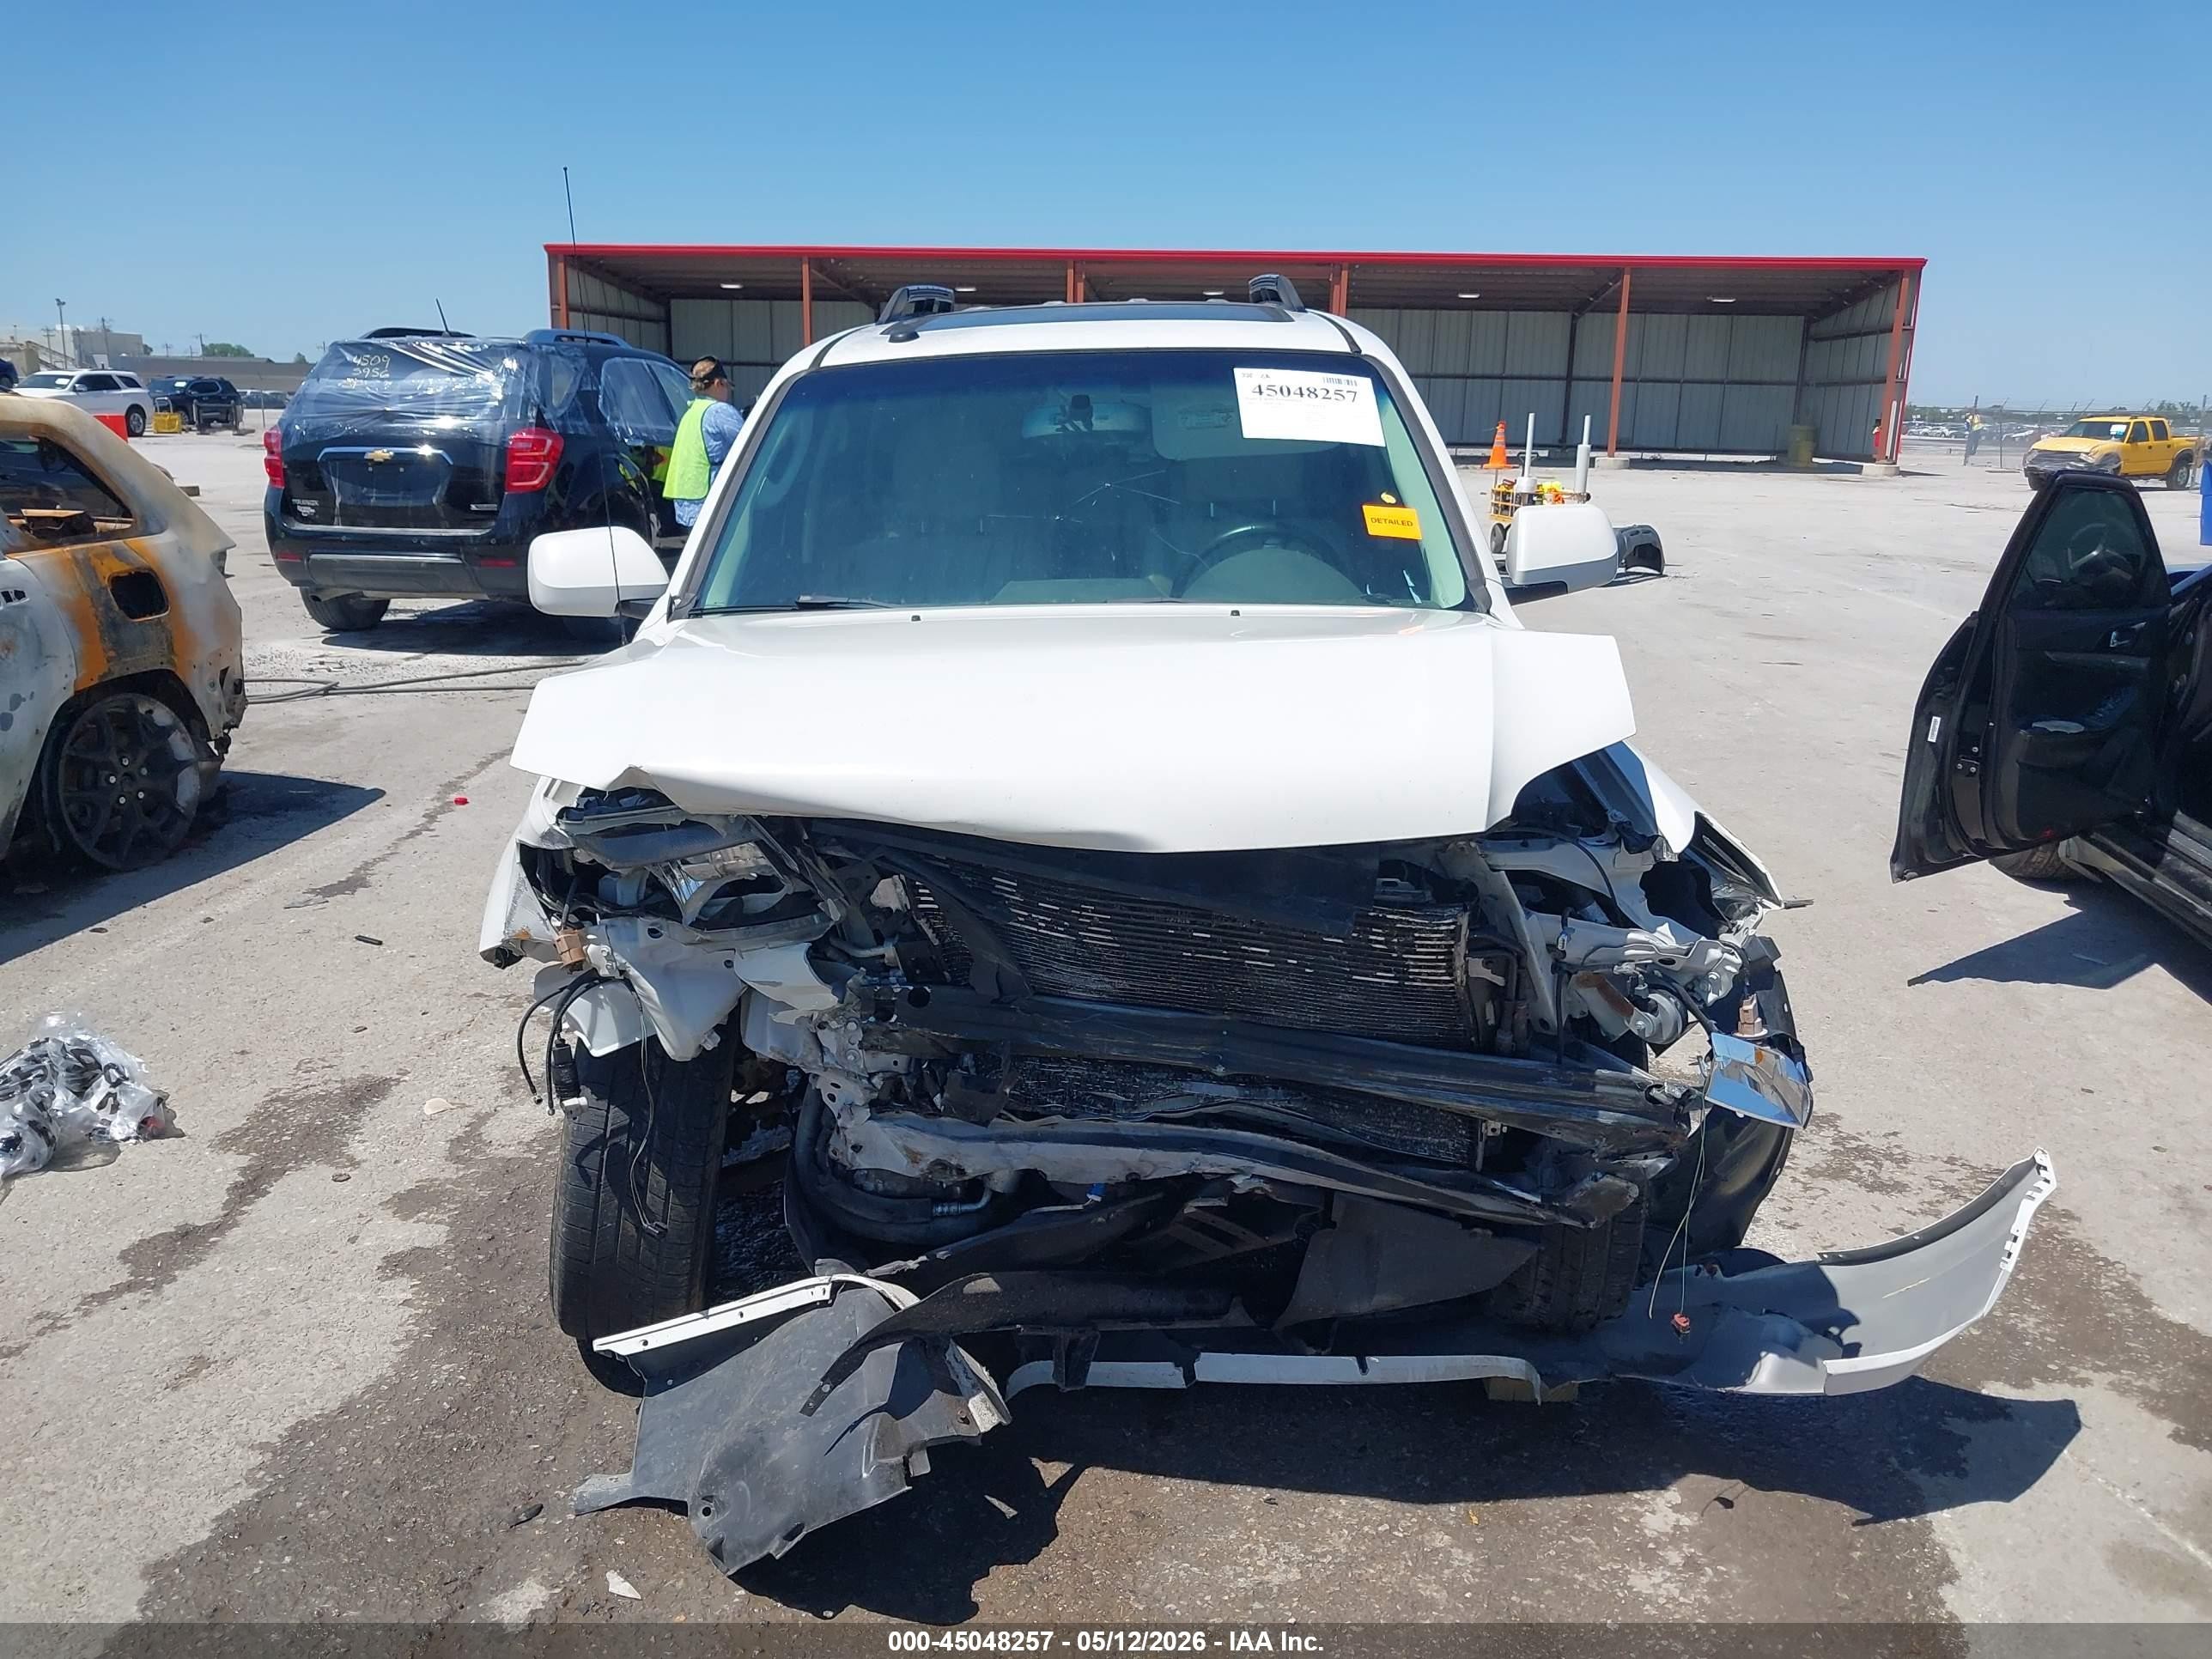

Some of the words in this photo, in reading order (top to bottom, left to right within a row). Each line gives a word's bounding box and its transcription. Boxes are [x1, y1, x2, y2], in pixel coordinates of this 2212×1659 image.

[352, 355, 391, 368] 4509
[1251, 384, 1358, 404] 45048257
[1370, 517, 1413, 527] DETAILED
